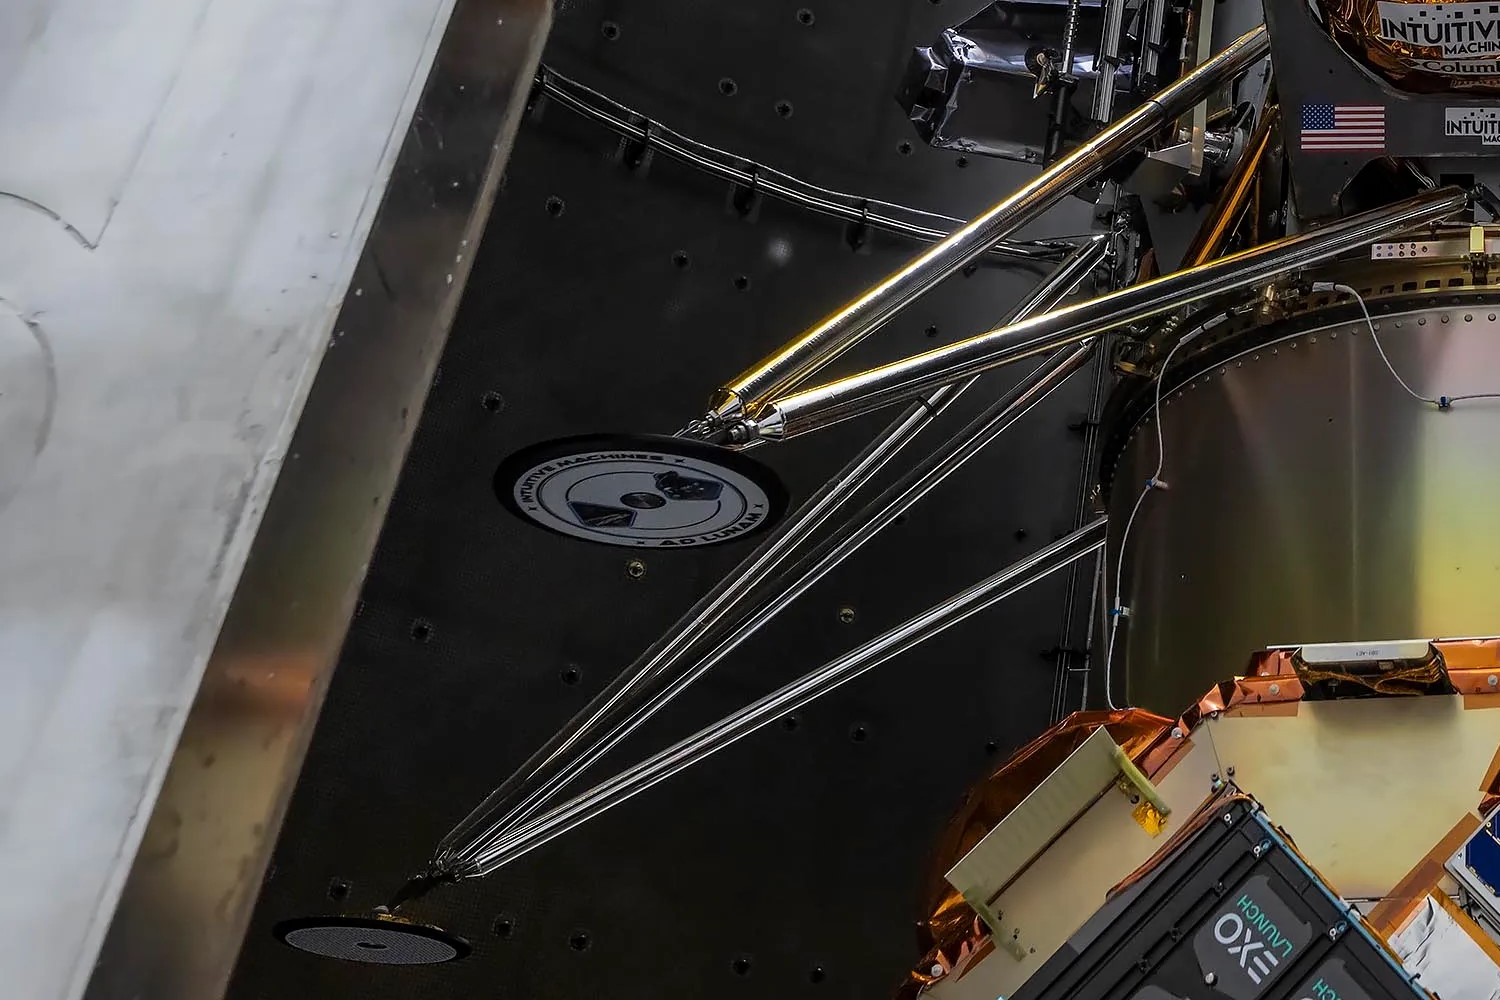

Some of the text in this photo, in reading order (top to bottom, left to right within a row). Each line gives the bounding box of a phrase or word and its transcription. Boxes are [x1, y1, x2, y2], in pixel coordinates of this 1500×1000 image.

[520, 453, 664, 503] INTUITIVE MACHINES
[701, 513, 762, 541] LUNAM
[1214, 912, 1279, 985] EXO
[1236, 894, 1293, 958] LAUNCH
